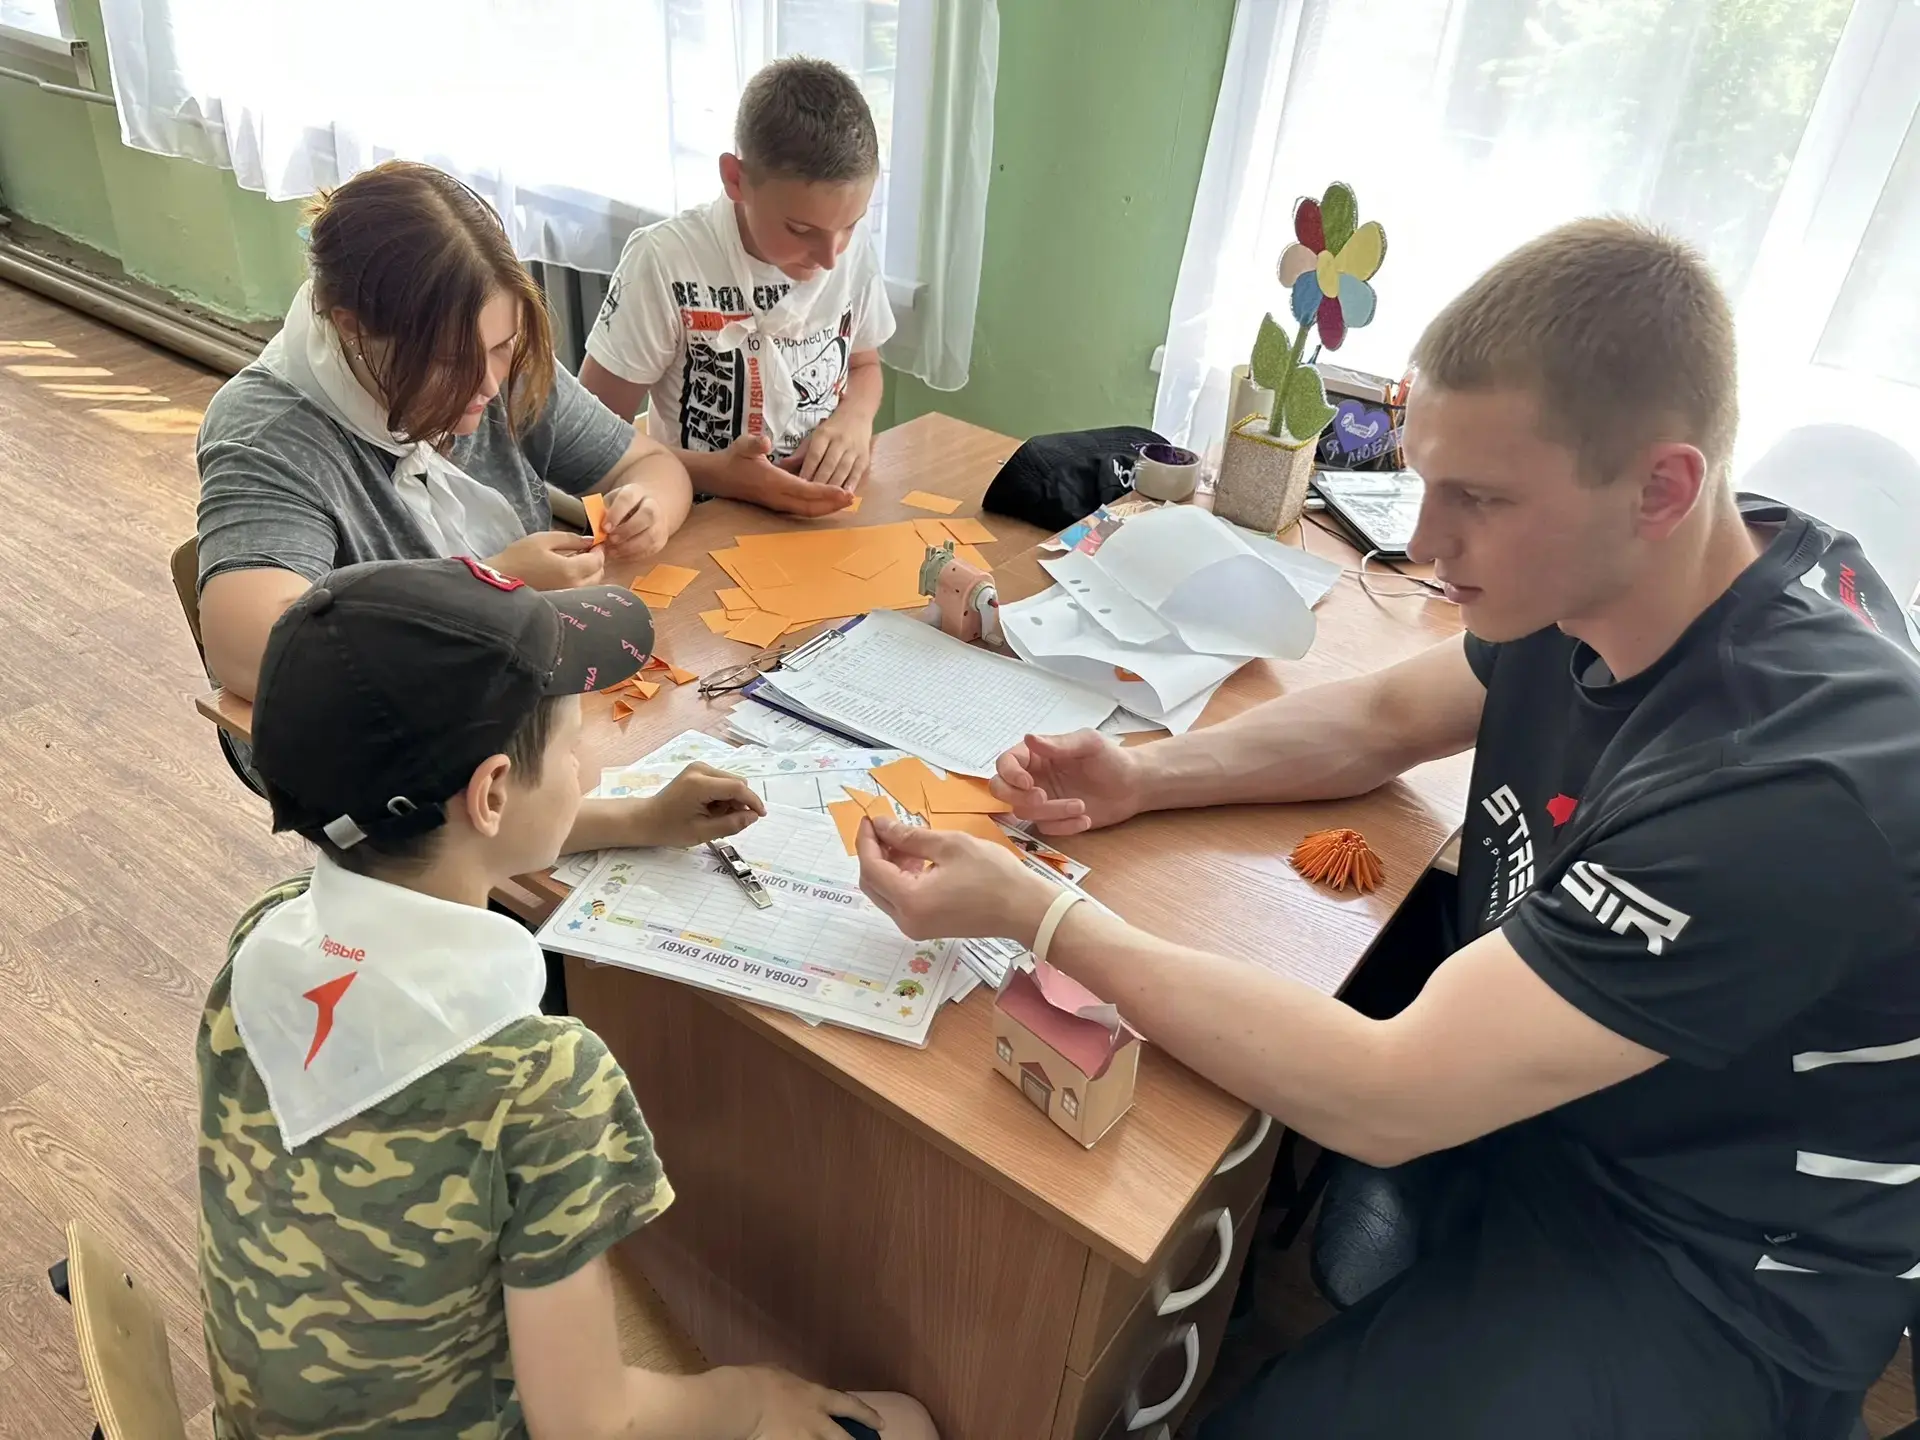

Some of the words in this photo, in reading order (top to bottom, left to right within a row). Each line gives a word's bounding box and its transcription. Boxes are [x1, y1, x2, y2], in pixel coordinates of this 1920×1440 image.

[747, 357, 764, 408] FISHING
[580, 602, 612, 618] FILA
[621, 639, 646, 663] FILA
[792, 882, 809, 895] НА
[812, 889, 853, 904] СЛОВА
[658, 940, 700, 957] БУКВУ
[702, 950, 739, 969] ОДНУ
[743, 962, 761, 975] НА
[765, 968, 808, 988] СЛОВА
